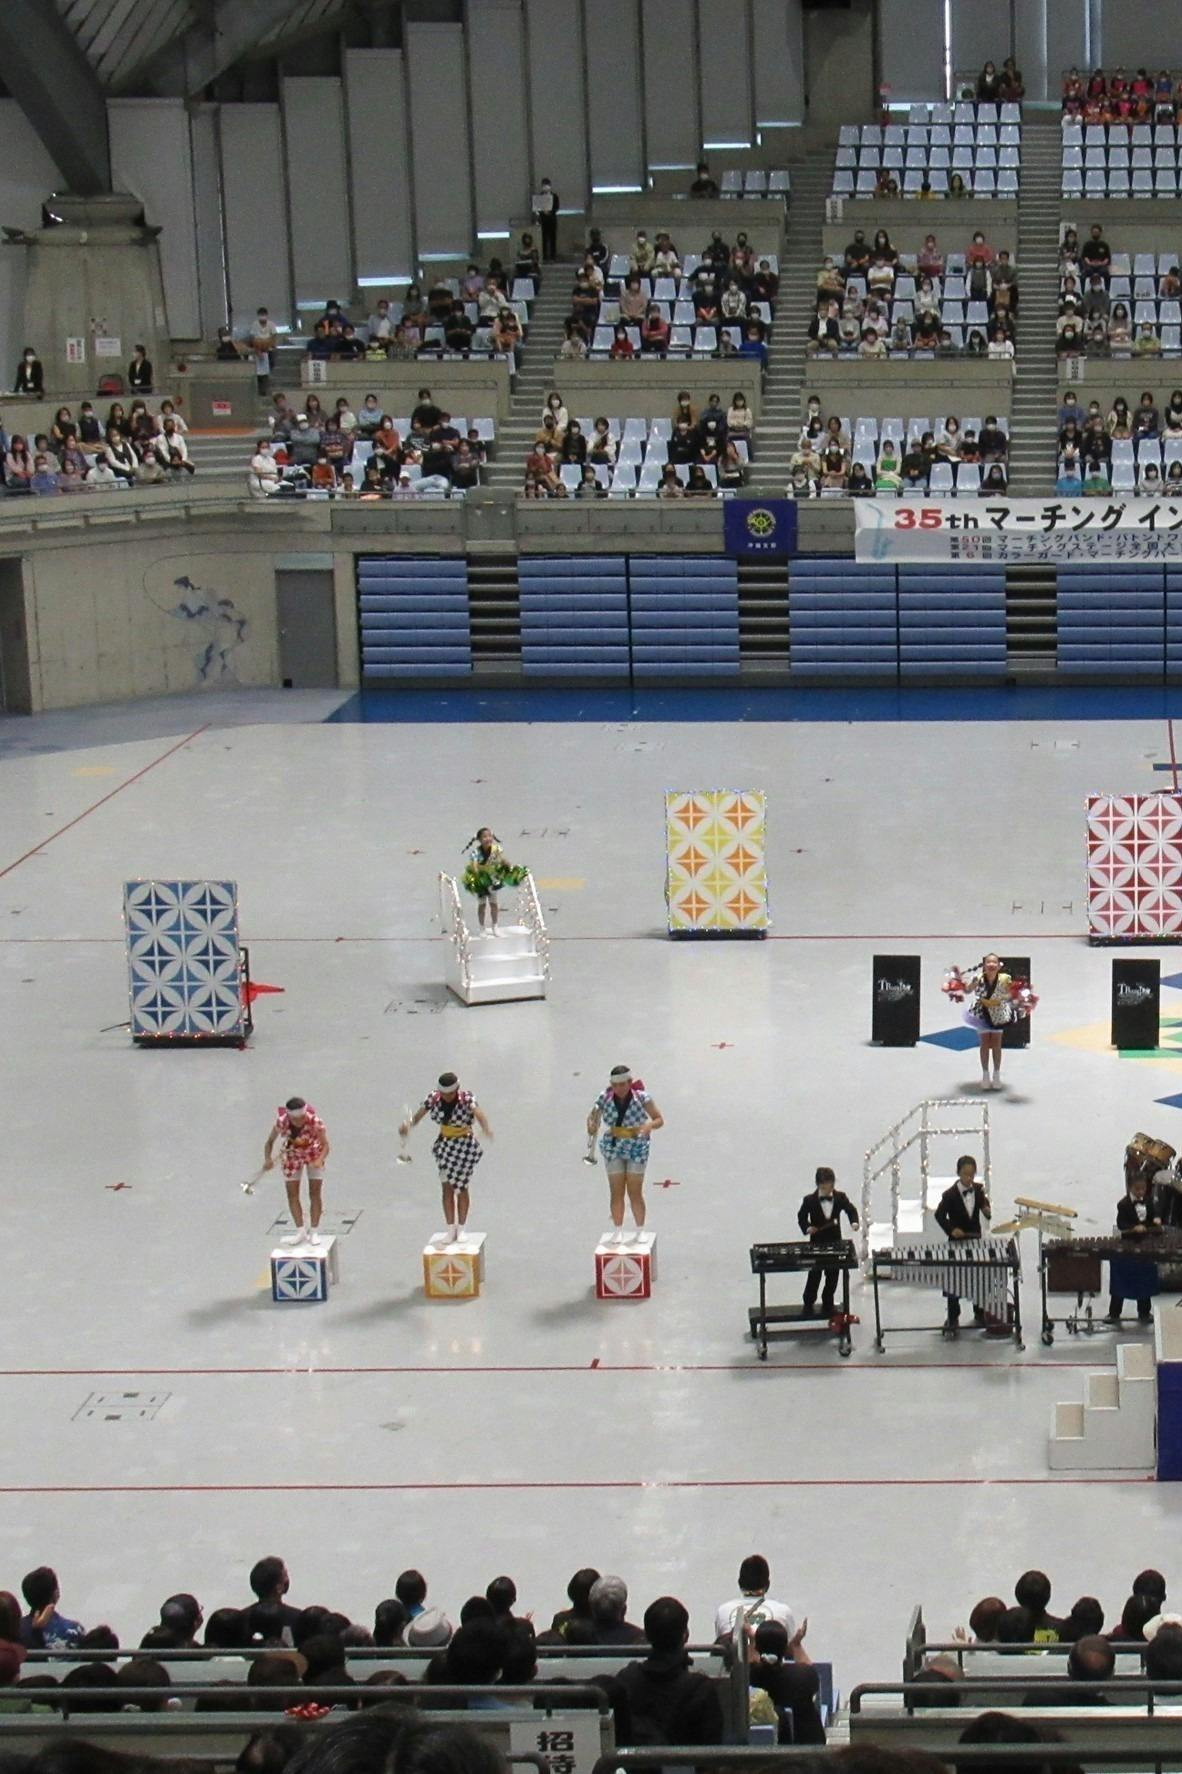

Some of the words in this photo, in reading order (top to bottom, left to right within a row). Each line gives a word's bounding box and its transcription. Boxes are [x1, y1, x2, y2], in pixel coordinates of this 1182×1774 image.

[894, 508, 979, 530] 35th
[986, 503, 1127, 532] マーチング
